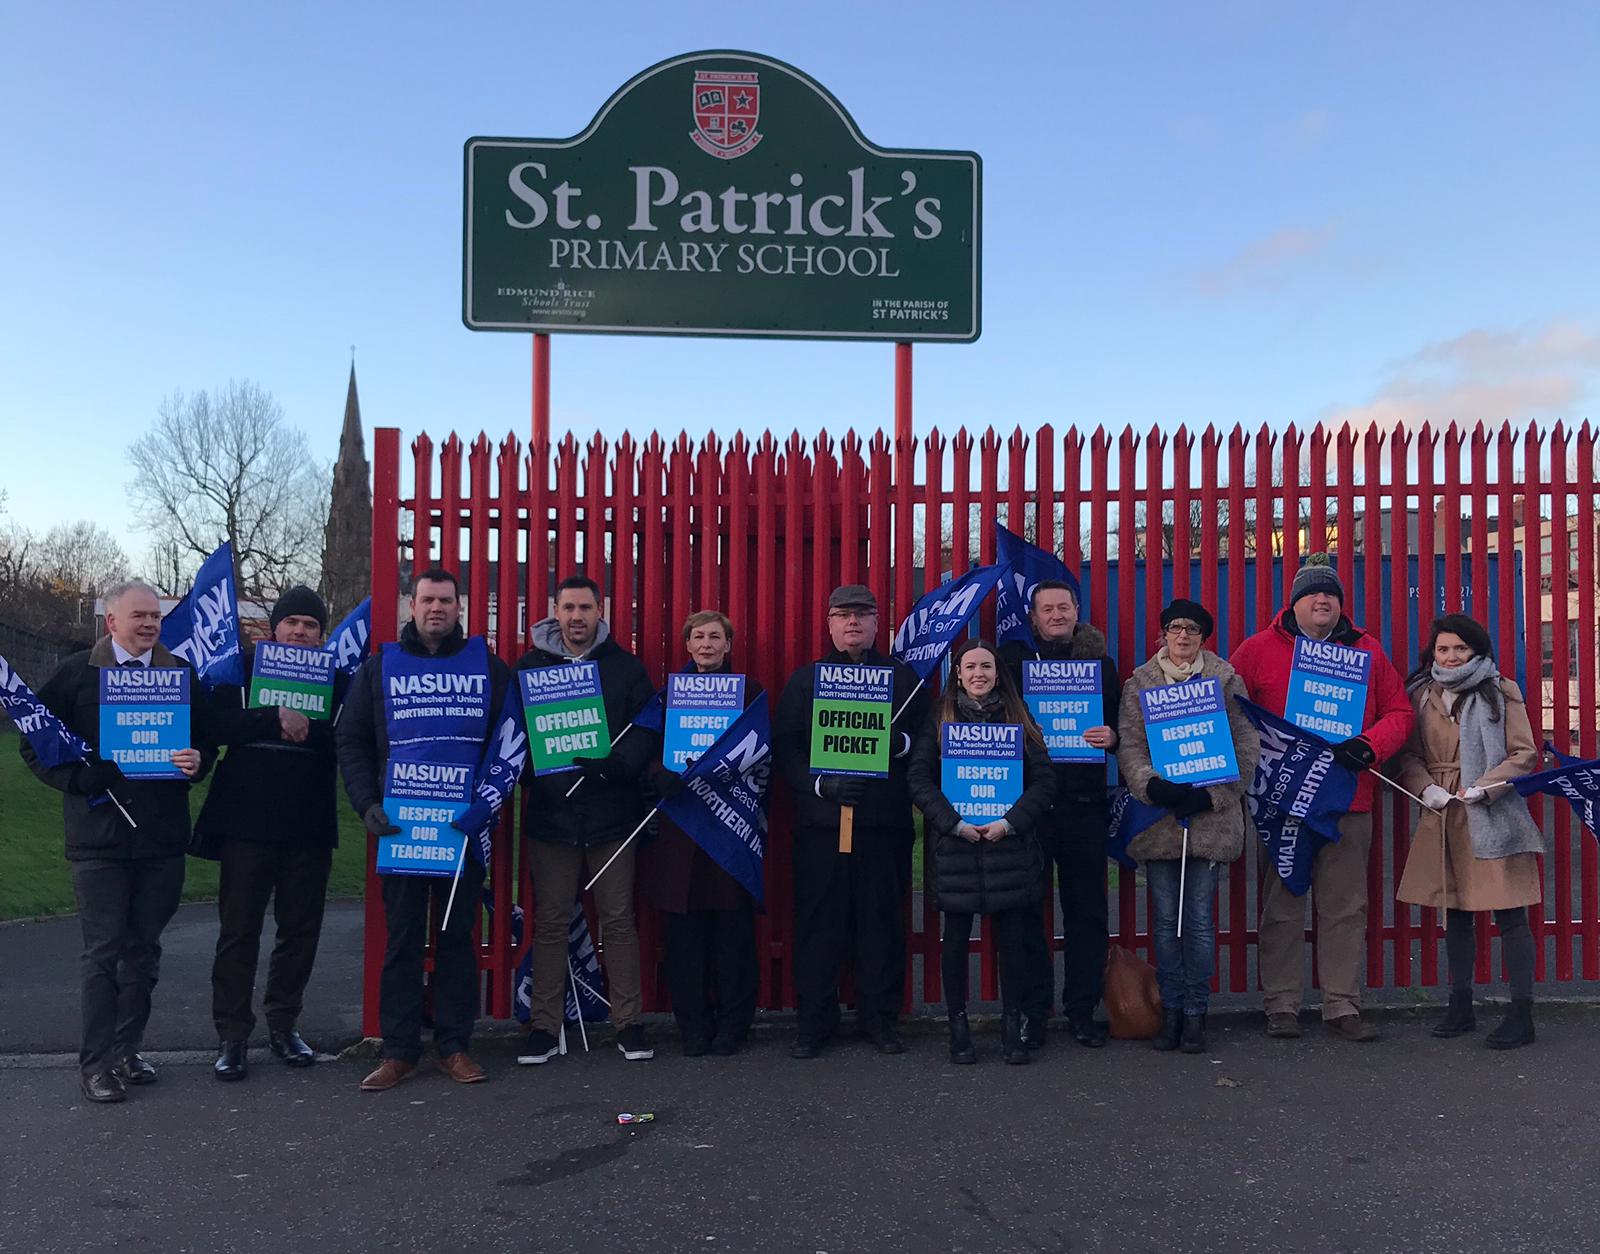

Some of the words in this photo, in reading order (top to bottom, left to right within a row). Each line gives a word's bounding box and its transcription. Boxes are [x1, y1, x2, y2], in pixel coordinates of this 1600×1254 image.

[506, 162, 602, 230] St.
[627, 166, 942, 240] Patrick's
[548, 238, 730, 272] PRIMARY
[736, 244, 900, 277] SCHOOL
[498, 288, 560, 297] EDMUND
[564, 290, 596, 298] RICE
[522, 297, 559, 307] Schools
[564, 298, 590, 308] Trust
[903, 300, 934, 308] PARISH
[872, 309, 886, 318] ST
[890, 310, 948, 320] PATRICK'S
[262, 644, 334, 668] NASUWT
[1300, 640, 1368, 667] NASUWT
[260, 668, 298, 678] NORTHERN
[299, 672, 328, 682] IRELAND
[526, 664, 594, 688] NASUWT
[820, 666, 892, 686] NASUWT
[1028, 663, 1096, 678] NASUWT
[1298, 662, 1334, 675] NORTHERN
[1334, 669, 1362, 680] IRELAND
[1344, 664, 1362, 673] Union
[107, 670, 184, 686] NASUWT
[390, 673, 486, 696] NASUWT
[674, 676, 740, 692] NASUWT
[530, 692, 566, 702] NORTHERN
[567, 688, 596, 696] IRELAND
[1146, 680, 1215, 706] NASUWT
[1304, 680, 1354, 702] RESPECT
[258, 688, 325, 712] OFFICIAL
[410, 696, 454, 704] Teachers'
[456, 696, 482, 704] Union
[1038, 701, 1090, 714] RESPECT
[1314, 700, 1338, 716] OUR
[116, 712, 174, 726] RESPECT
[394, 708, 443, 720] NORTHERN
[446, 707, 484, 718] IRELAND
[536, 708, 602, 732] OFFICIAL
[818, 709, 886, 730] OFFICIAL
[1150, 710, 1187, 720] NORTHERN
[1188, 704, 1217, 713] IRELAND
[680, 716, 730, 730] RESPECT
[1052, 718, 1076, 730] OUR
[1162, 720, 1214, 742] RESPECT
[1296, 712, 1352, 737] TEACHERS
[132, 730, 158, 744] OUR
[691, 733, 715, 746] OUR
[948, 726, 1018, 742] NASUWT
[544, 731, 598, 754] PICKET
[823, 734, 880, 755] PICKET
[1179, 740, 1205, 756] OUR
[393, 763, 469, 784] NASUWT
[957, 766, 1009, 780] RESPECT
[1164, 754, 1226, 777] TEACHERS
[1574, 769, 1600, 791] The
[392, 788, 432, 796] NORTHERN
[432, 790, 464, 798] IRELAND
[970, 784, 996, 798] OUR
[398, 806, 456, 823] RESPECT
[688, 776, 752, 842] NORTHERN
[412, 826, 438, 840] OUR
[390, 844, 455, 861] TEACHERS
